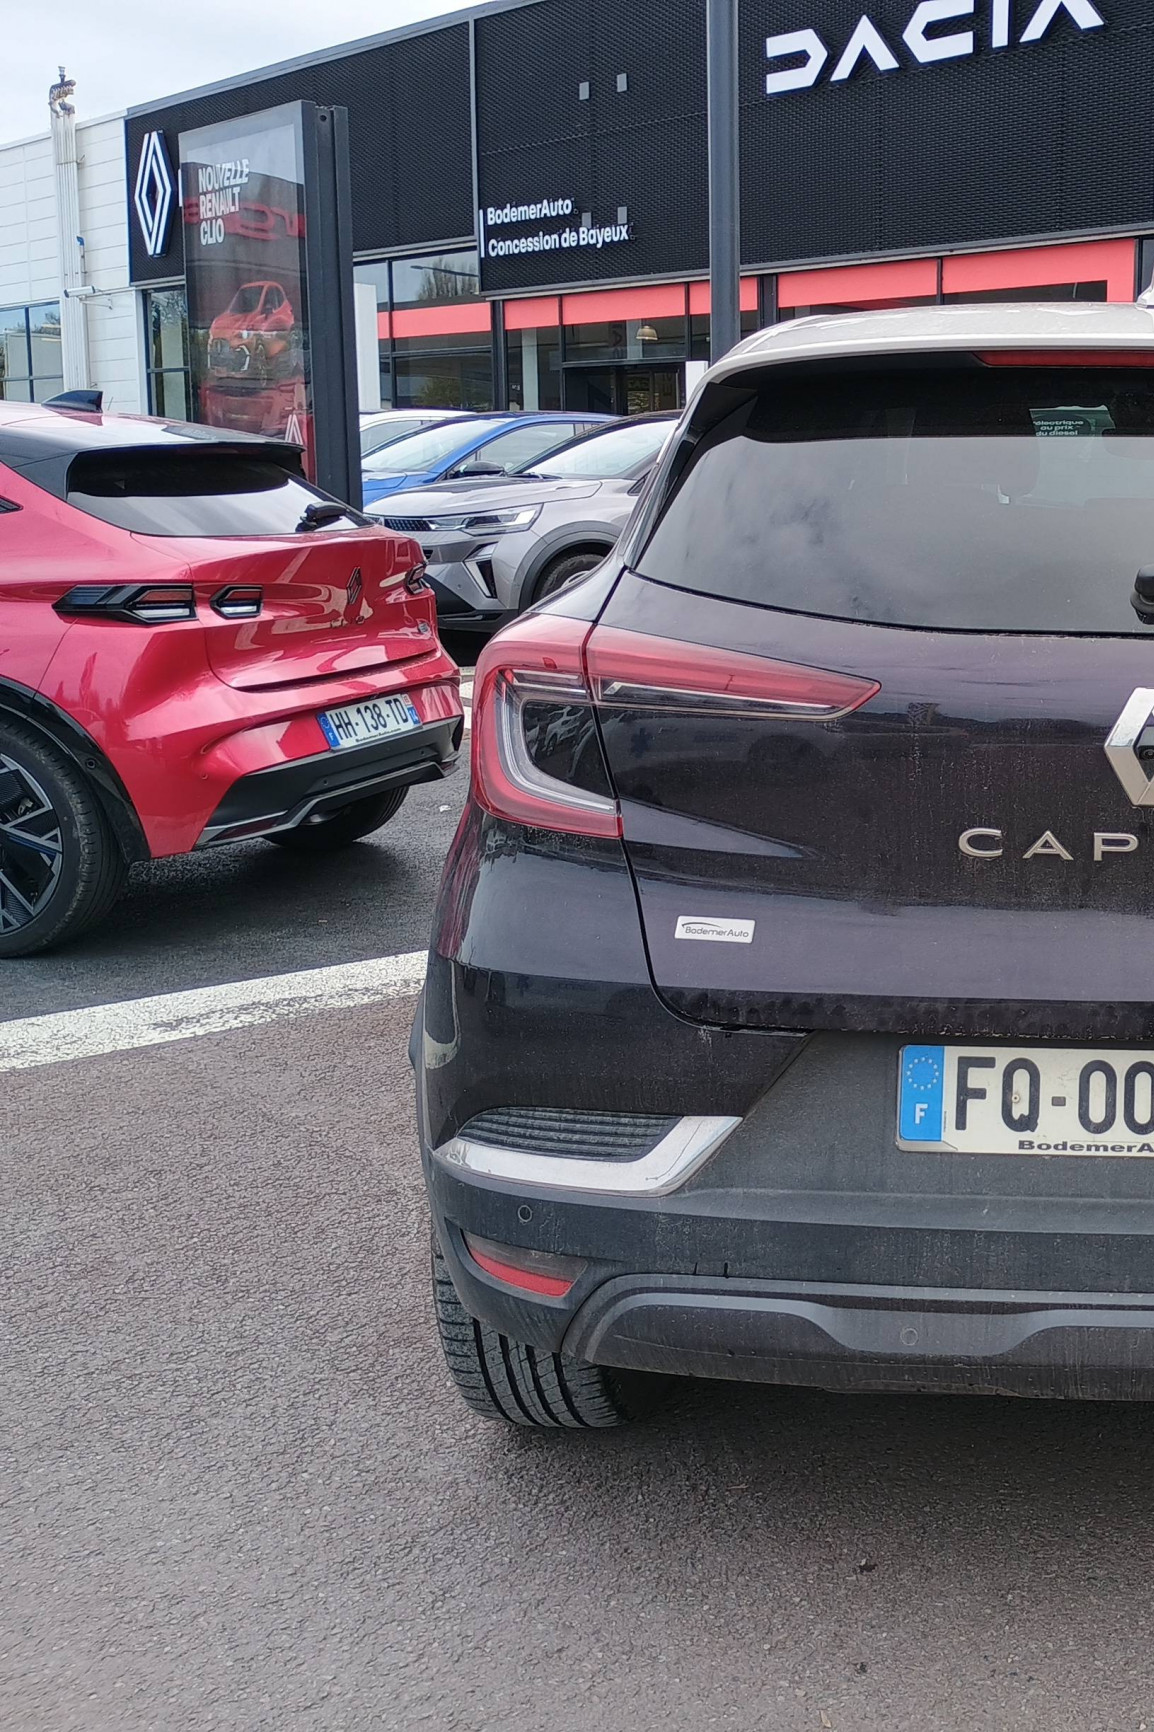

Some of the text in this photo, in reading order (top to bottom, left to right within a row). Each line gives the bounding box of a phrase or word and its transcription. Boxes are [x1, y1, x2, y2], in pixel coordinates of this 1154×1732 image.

[765, 0, 1105, 95] DACIA
[198, 159, 249, 193] NOUVELLE
[199, 186, 240, 219] RENAULT
[487, 198, 572, 225] BodemerAuto
[200, 218, 225, 245] CLIO
[488, 224, 629, 257] Concession de Bayeux
[329, 697, 410, 741] HH-138-TD
[684, 926, 750, 938] BodemerAuto
[914, 1102, 929, 1124] F
